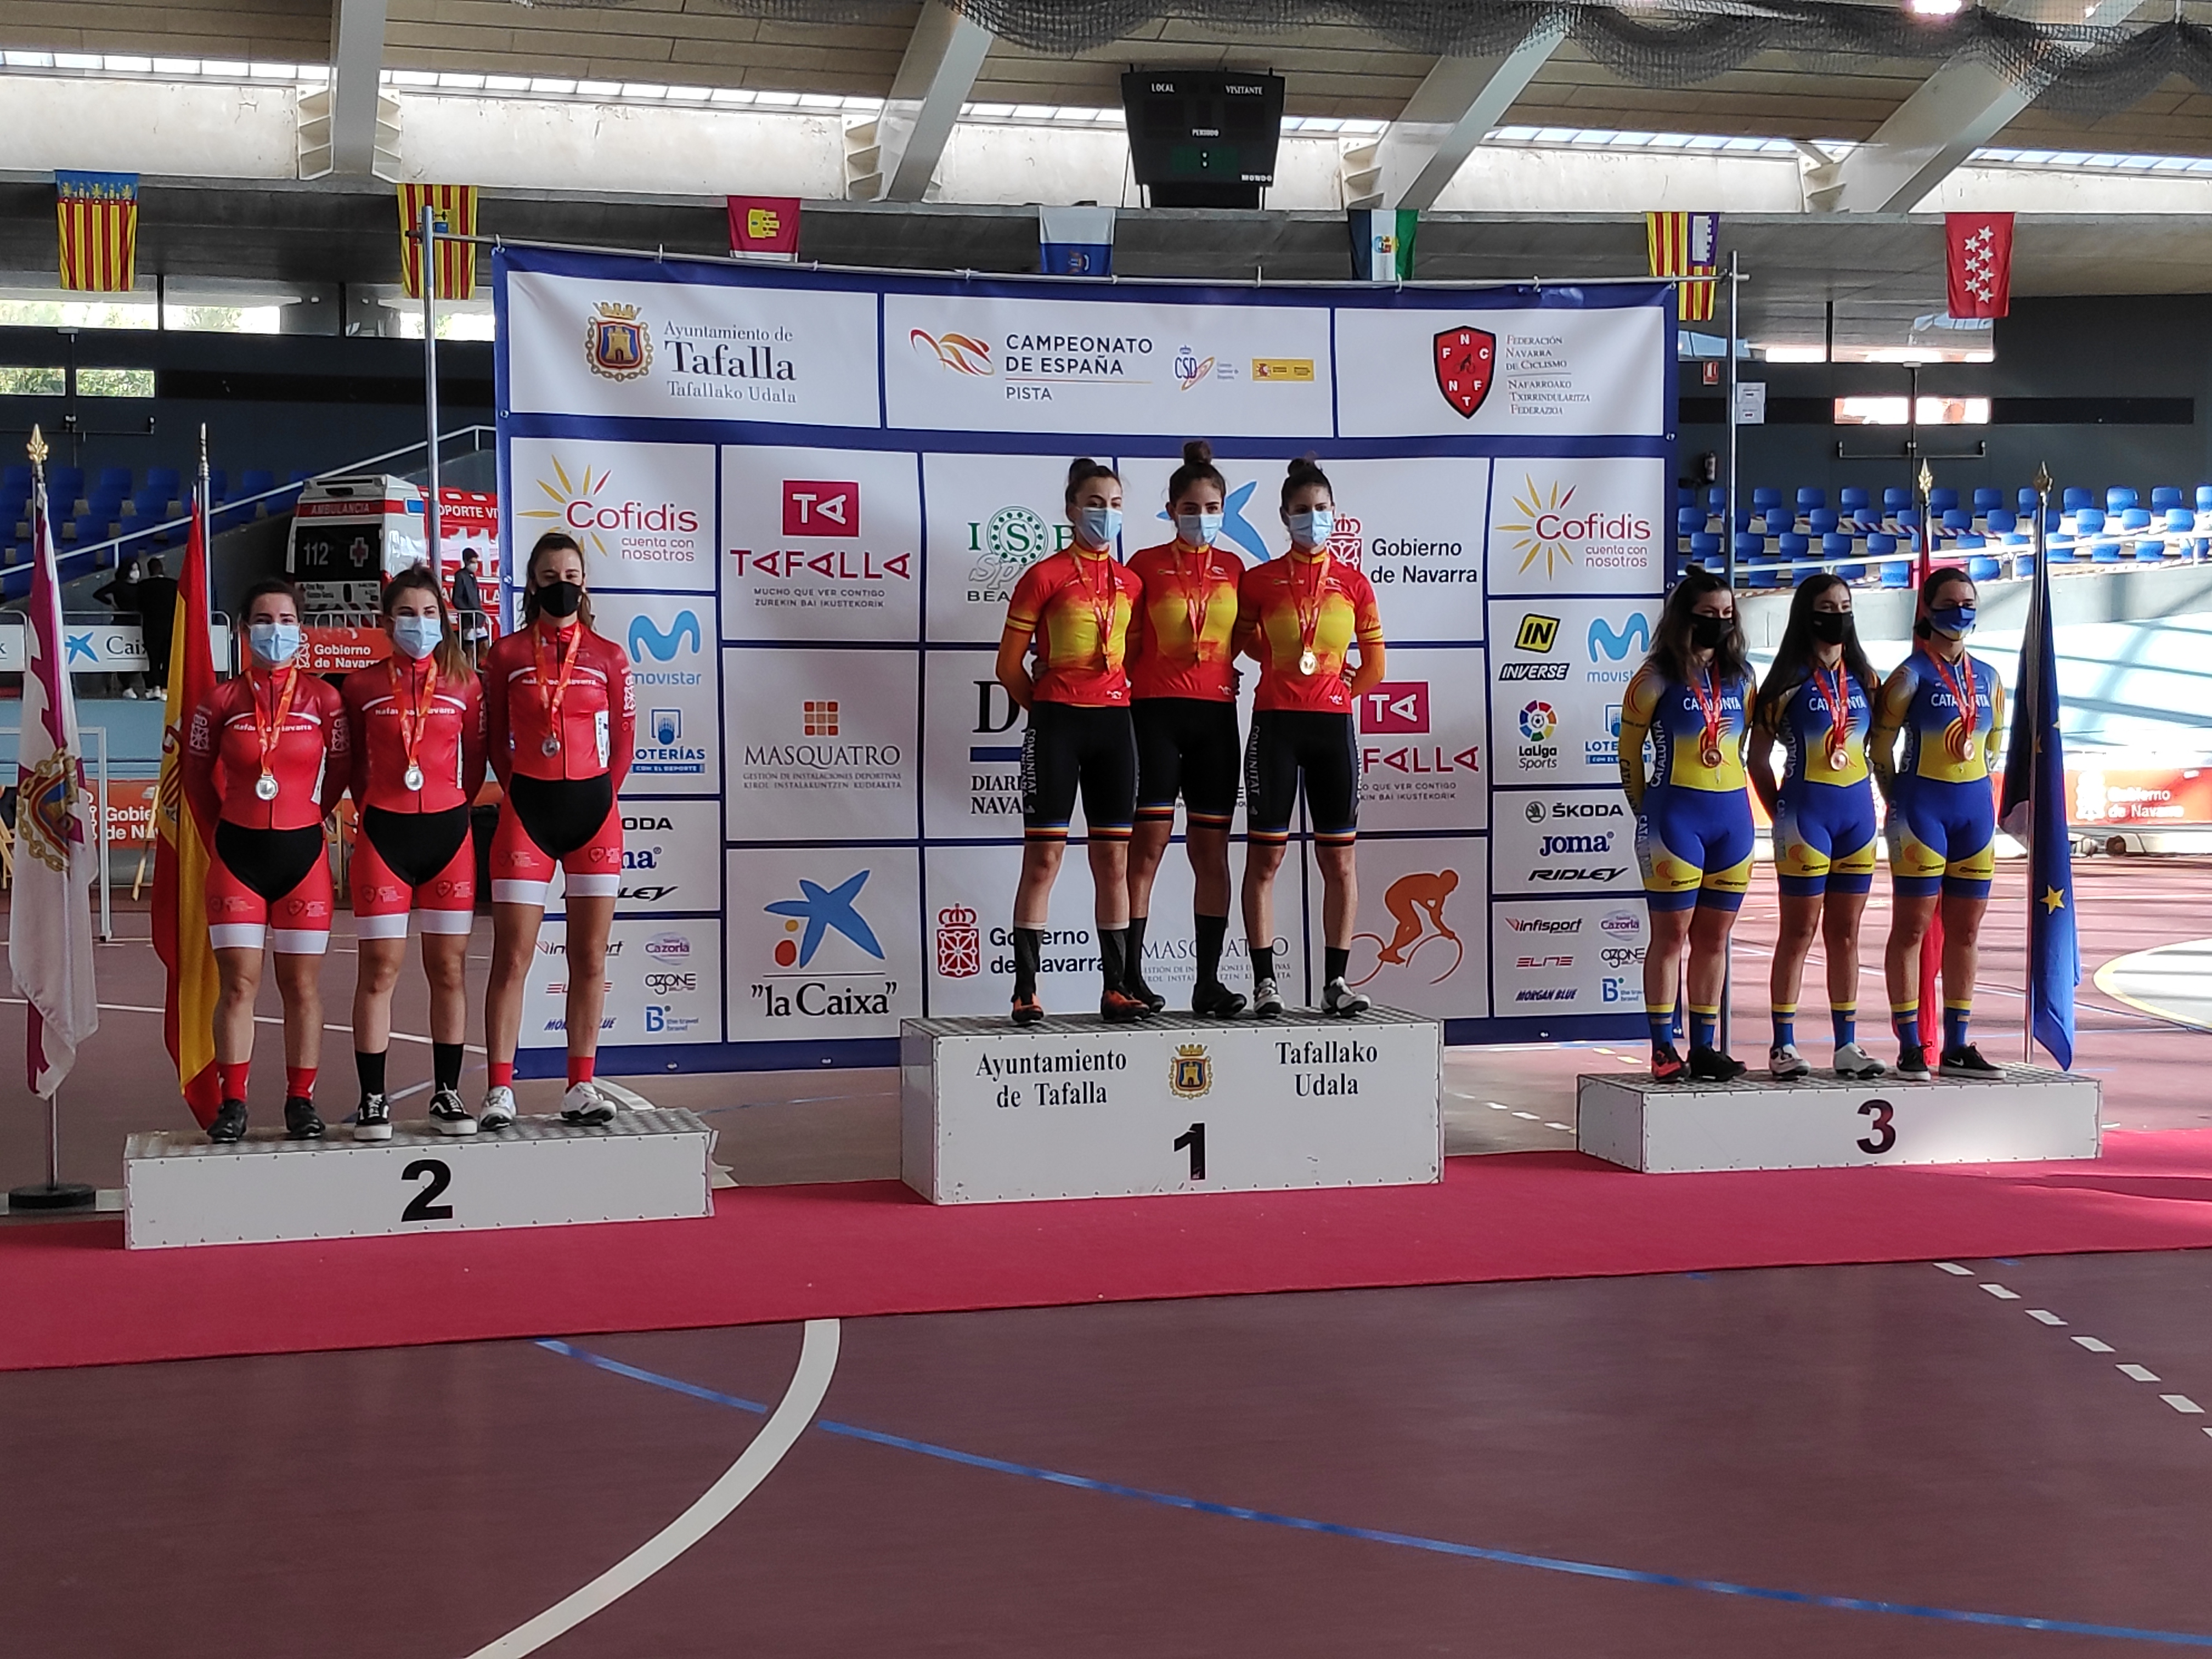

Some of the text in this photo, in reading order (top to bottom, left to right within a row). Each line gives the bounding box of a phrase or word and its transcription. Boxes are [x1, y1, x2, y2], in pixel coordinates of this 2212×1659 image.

[1152, 83, 1263, 95] LOCAL VISITANTE
[664, 320, 793, 342] Ayuntamiento de
[1006, 334, 1153, 354] CAMPEONATO
[664, 341, 797, 381] Tafalla
[1006, 354, 1124, 376] DE ESPAÑA
[1175, 357, 1197, 379] CSD
[667, 381, 797, 404] Tafallako Udala
[1006, 386, 1053, 402] PISTA
[312, 503, 370, 515] AMBULANCIA
[438, 504, 484, 518] OPORTE
[566, 500, 699, 532] Cofidis
[1536, 512, 1651, 540] Cofidis
[621, 537, 695, 548] cuenta con
[1372, 538, 1463, 556] Gobierno
[1585, 545, 1647, 555] cuenta con
[303, 541, 329, 566] 112
[621, 549, 695, 562] nosotros
[1585, 555, 1647, 567] nosotros
[730, 549, 911, 580] TAFALLA
[1371, 565, 1477, 583] de Navarra
[754, 588, 885, 598] MUCHO QUE VER CONTIGO
[755, 599, 884, 608] ZUREKIN BAI IKUSTEKORIK
[1522, 622, 1553, 645] IN
[314, 644, 371, 656] Gobierno
[314, 659, 335, 669] de
[1501, 664, 1567, 679] INVERSE
[632, 671, 702, 685] movistar
[634, 746, 706, 760] OTERÍAS
[744, 745, 901, 770] MASQUATRO
[1518, 744, 1558, 758] LaLiga
[1025, 729, 1037, 795] COMUNITAT
[1363, 746, 1479, 774] FALLA
[1518, 757, 1558, 771] Sports
[743, 772, 778, 780] GESTIÓN
[1372, 782, 1391, 791] QUE
[1394, 782, 1413, 790] VER
[1415, 781, 1457, 790] CONTIGO
[970, 796, 1024, 815] NAVA
[1551, 802, 1624, 818] ŠKODA
[622, 817, 674, 831] ODA
[1528, 867, 1629, 882] RIDLEY
[1601, 919, 1640, 930] Cazorla
[989, 928, 1090, 946] Goerno
[645, 942, 690, 953] Cazorla
[1141, 936, 1289, 960] MASATO
[990, 955, 1017, 974] de
[1515, 989, 1578, 1002] MORGAN BLUE
[600, 1017, 617, 1029] LUE
[975, 1040, 1378, 1079] Ayuntamiento Tafallako
[1294, 1072, 1359, 1098] Udala
[996, 1081, 1108, 1108] de Tafalla
[1855, 1099, 1897, 1154] 3
[1173, 1122, 1207, 1181] 1
[400, 1159, 454, 1222] 2
